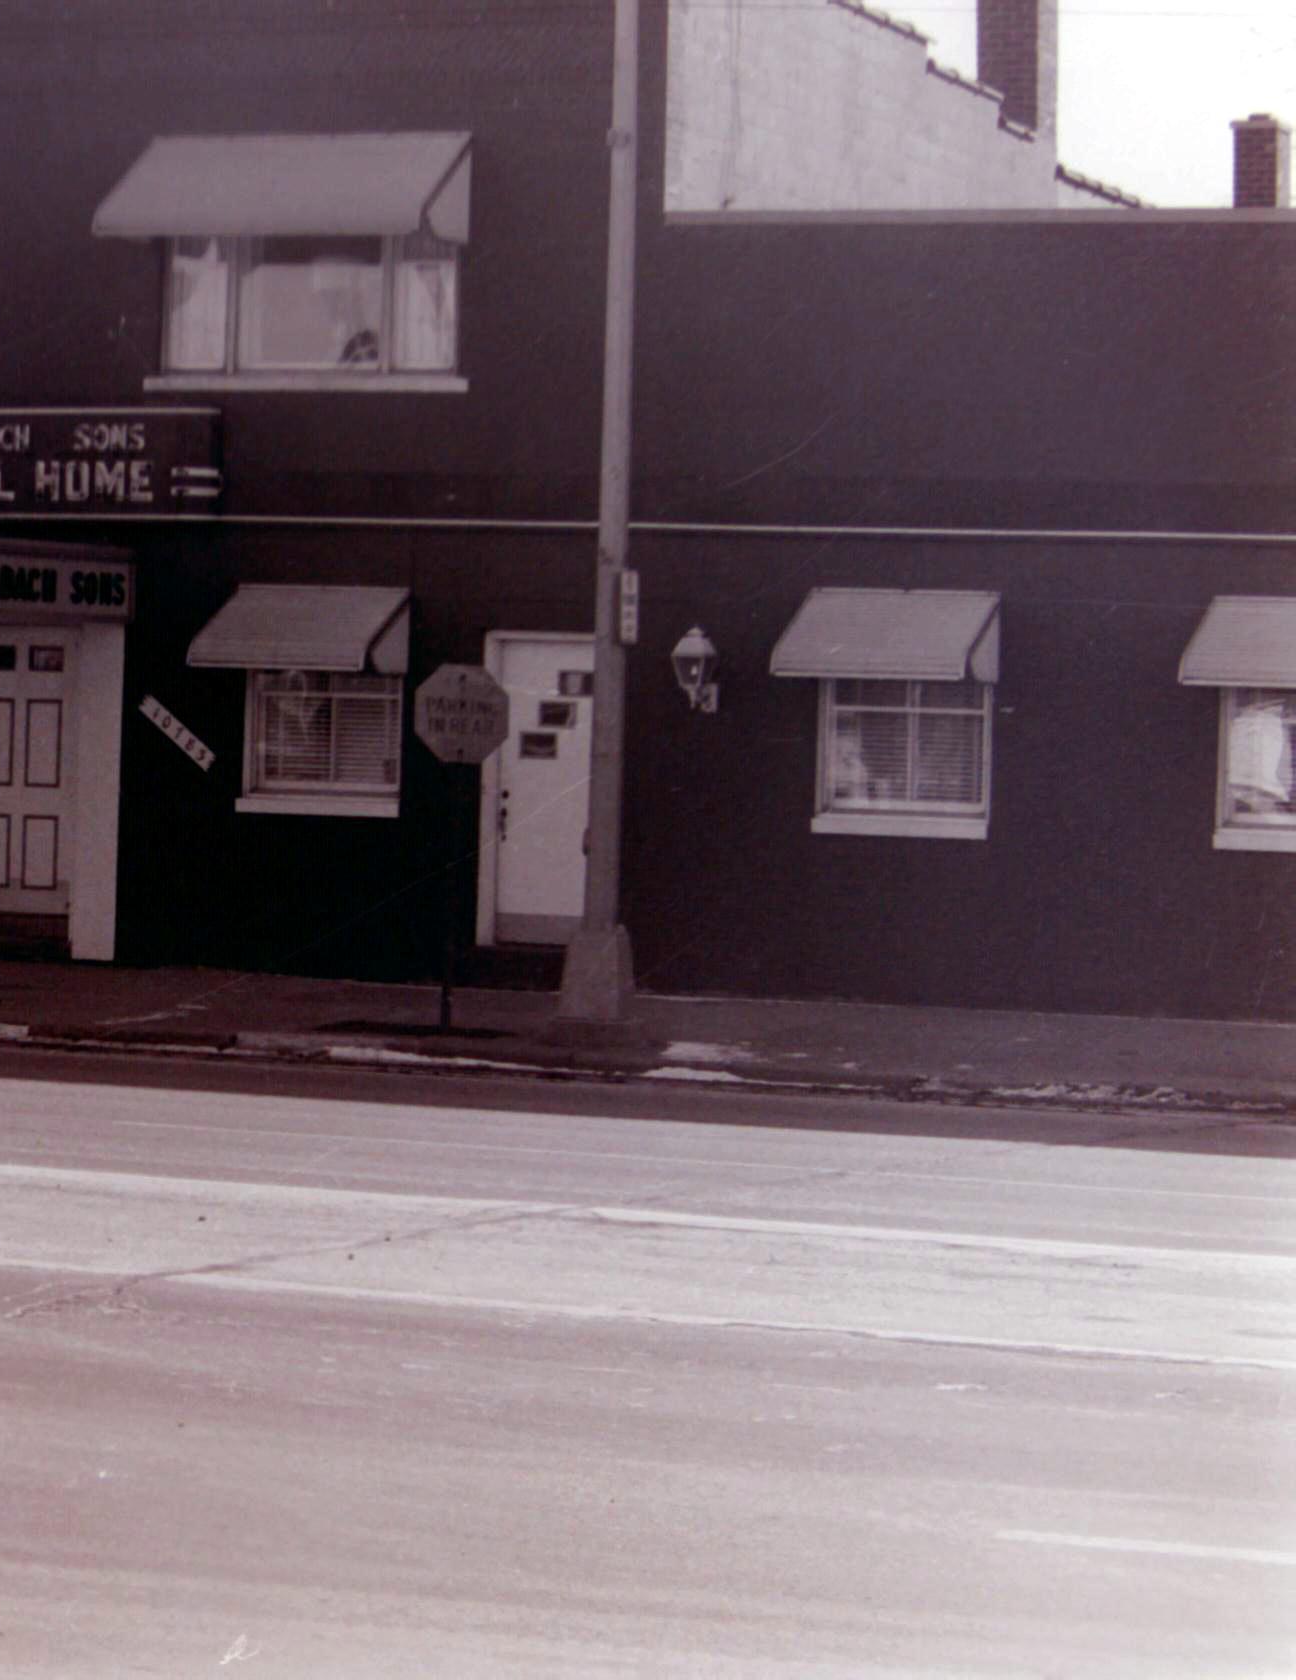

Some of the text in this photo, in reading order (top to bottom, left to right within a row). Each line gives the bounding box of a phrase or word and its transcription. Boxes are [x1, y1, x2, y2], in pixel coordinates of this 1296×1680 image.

[73, 423, 146, 452] SONS
[35, 460, 154, 503] HOME
[70, 570, 126, 606] SONS
[152, 707, 207, 761] 10783
[427, 717, 446, 733] IN
